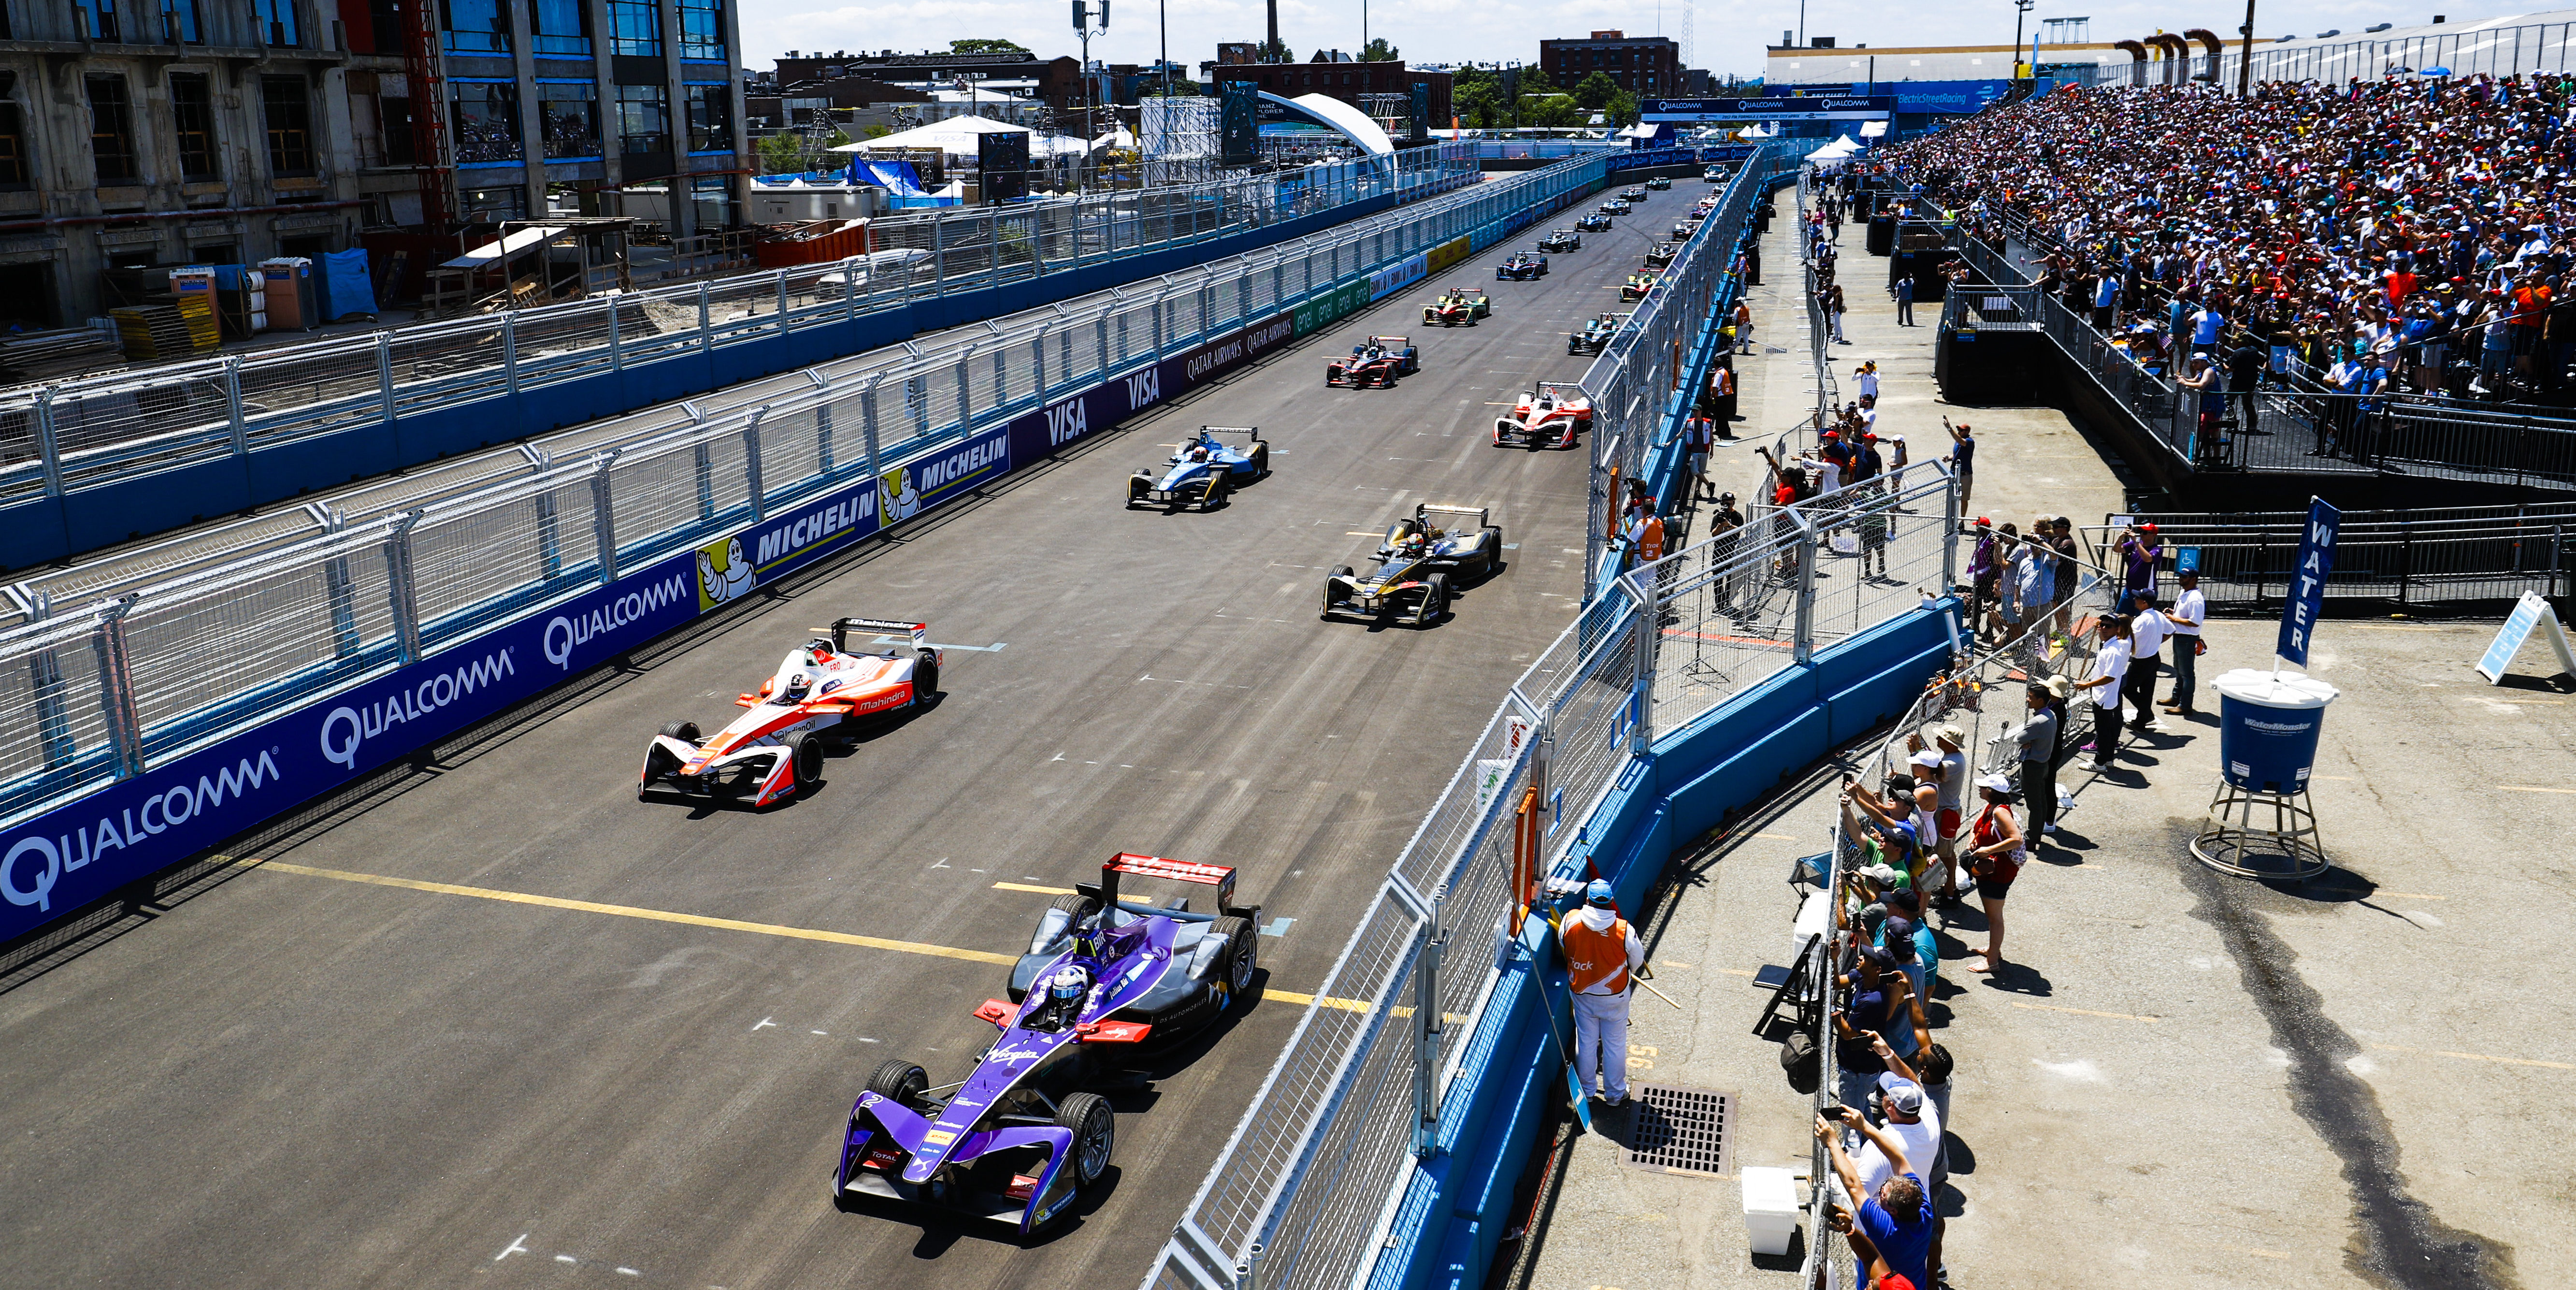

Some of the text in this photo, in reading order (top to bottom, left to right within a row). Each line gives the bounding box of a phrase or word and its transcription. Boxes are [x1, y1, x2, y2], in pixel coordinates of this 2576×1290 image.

[1659, 99, 1870, 112] QUALCOMM QUALCOMM QUALCOMM
[1338, 289, 1351, 313] enel
[1356, 281, 1368, 305] enel
[1297, 305, 1312, 332] enel
[1319, 297, 1332, 322] enel
[1247, 319, 1291, 354] QATAR AIRWAYS
[1188, 339, 1241, 381] QATAR AIRWAYS
[1125, 367, 1159, 410] VISA
[1044, 397, 1087, 446] VISA
[921, 435, 1007, 492] MICHELIN
[756, 490, 876, 565] MICHELIN
[2291, 520, 2332, 652] WATER
[544, 573, 687, 671] QUALCOMM
[849, 619, 918, 628] Mahindra
[321, 649, 515, 769] QUALCOMM
[860, 690, 905, 711] Mahindra
[2245, 717, 2311, 731] WaterMonster
[0, 749, 280, 913] QUALCOMM
[1093, 931, 1106, 951] BIR
[1109, 985, 1122, 1000] Julius
[1169, 996, 1207, 1020] AUTOMOBILES
[989, 1043, 1039, 1066] Virgin
[860, 1094, 884, 1108] 2
[872, 1151, 897, 1161] TOTAL
[1013, 1178, 1036, 1189] TOTA
[1052, 1189, 1076, 1211] MICHELIN
